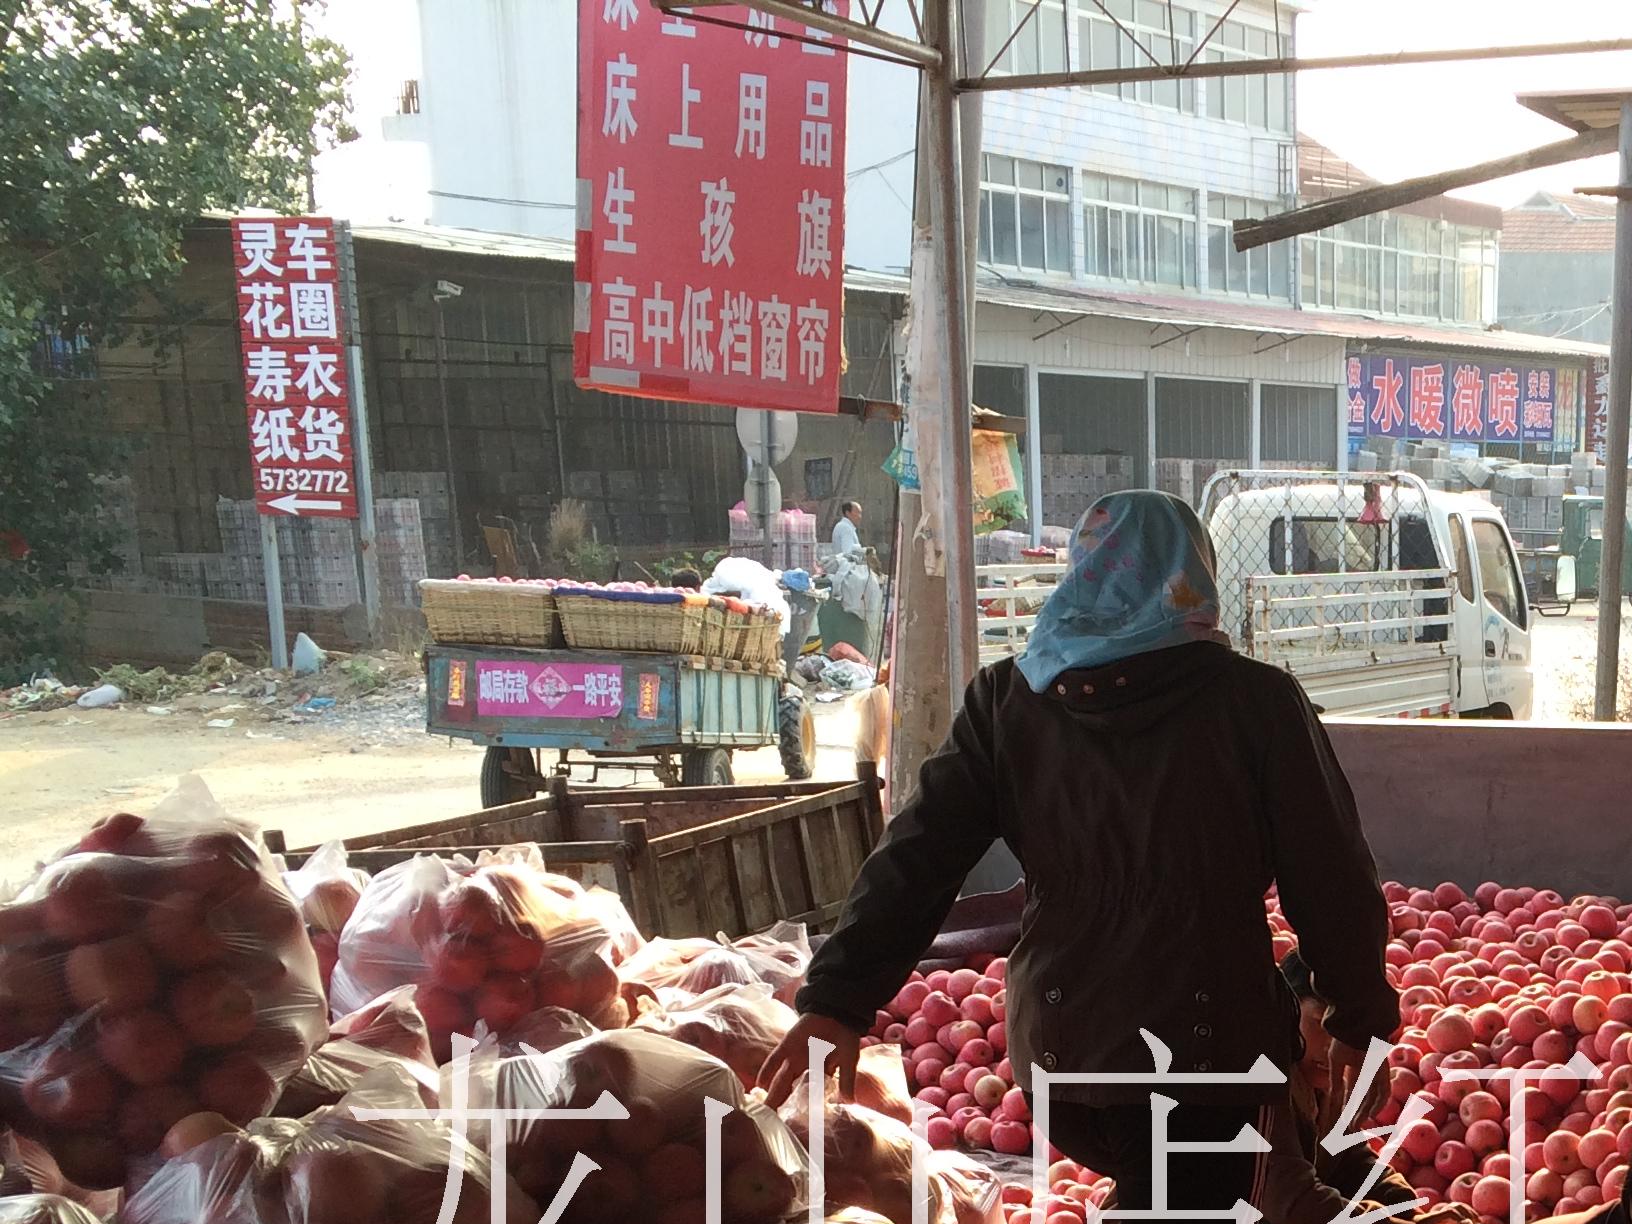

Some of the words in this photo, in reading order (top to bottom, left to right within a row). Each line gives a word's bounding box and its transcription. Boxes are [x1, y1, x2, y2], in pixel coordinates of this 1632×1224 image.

[602, 52, 833, 168] 床上用品
[238, 222, 332, 281] 灵车
[602, 166, 832, 280] 生孩旗
[240, 282, 338, 339] 花圈
[602, 276, 829, 386] 高中低档窗帘
[247, 345, 342, 402] 寿衣
[1371, 358, 1520, 438] 水暖微喷
[251, 406, 344, 463] 纸货
[260, 468, 349, 493] 5732772
[572, 673, 622, 707] 一路平安
